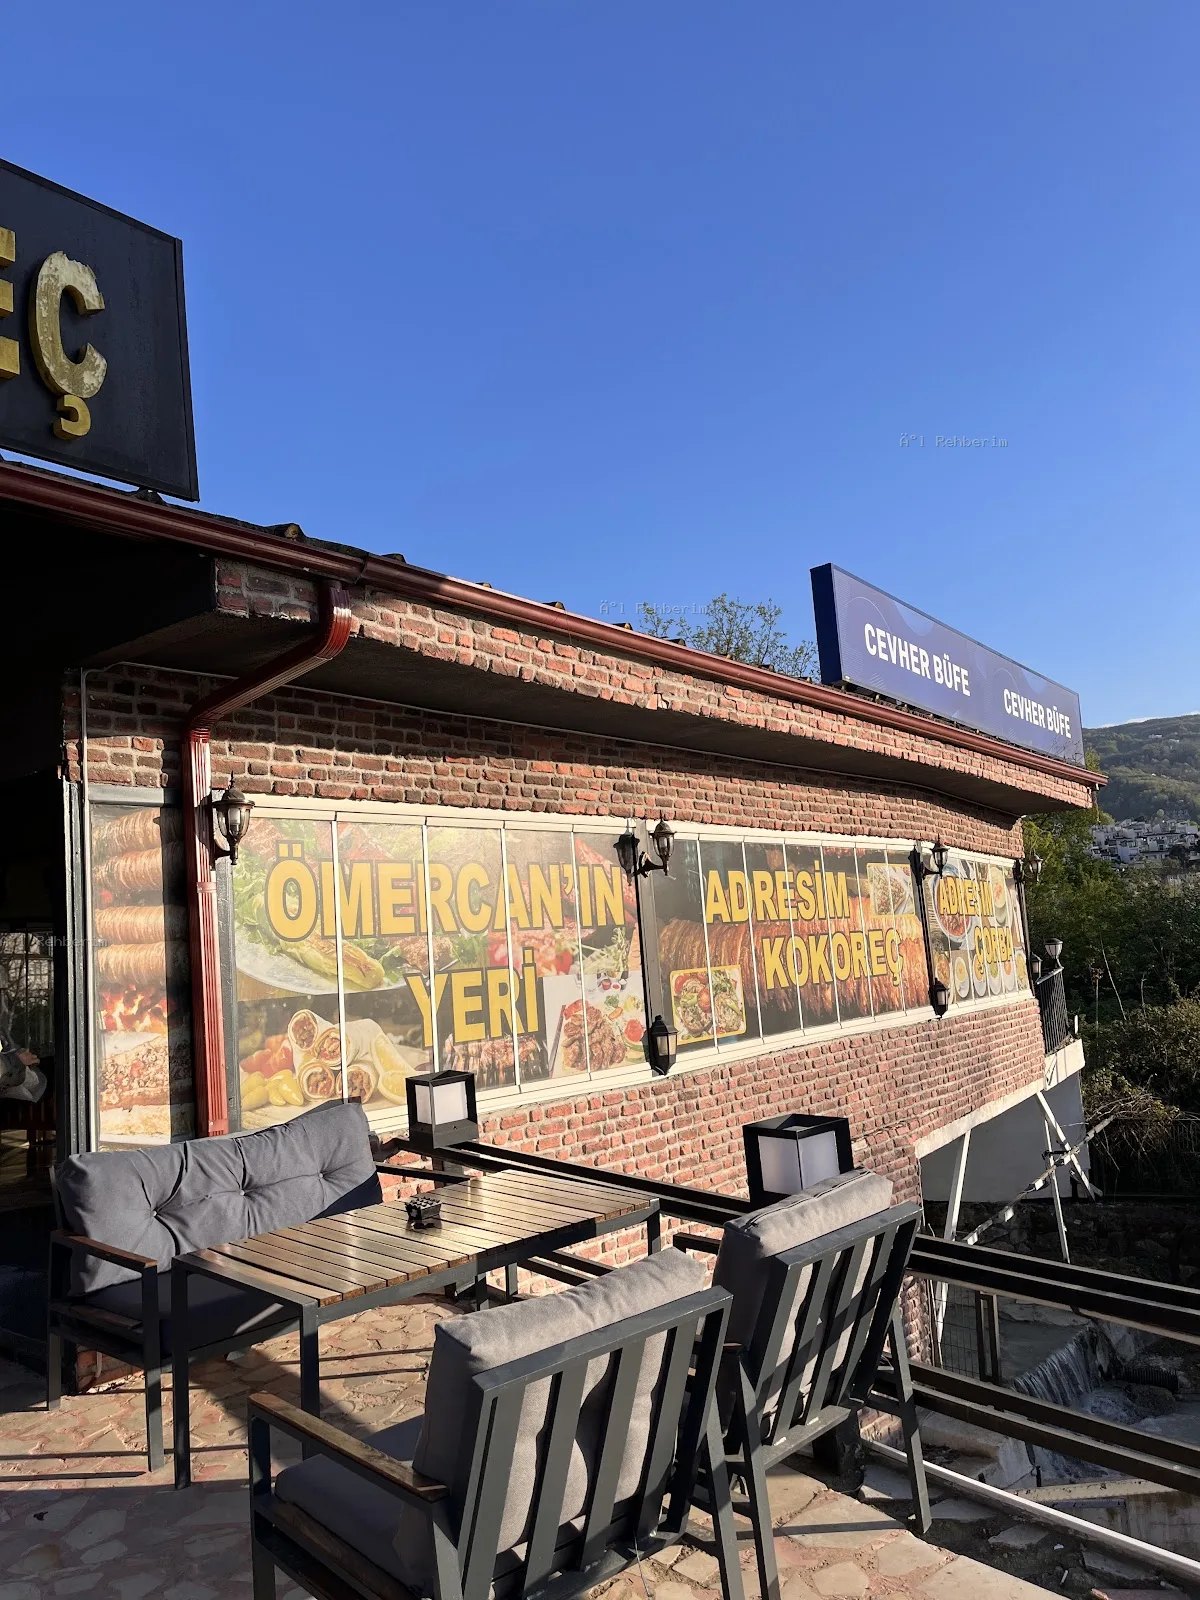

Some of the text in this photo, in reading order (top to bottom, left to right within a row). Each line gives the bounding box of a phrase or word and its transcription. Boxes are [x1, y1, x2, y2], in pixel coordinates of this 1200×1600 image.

[864, 623, 970, 697] CEVHER BÜFE
[1003, 688, 1072, 739] CEVHER BÜFE
[705, 861, 851, 924] ADRESİM
[761, 928, 904, 990] KOKOREÇ
[974, 925, 1014, 975] ÇORBA
[404, 947, 540, 1049] YERİ
